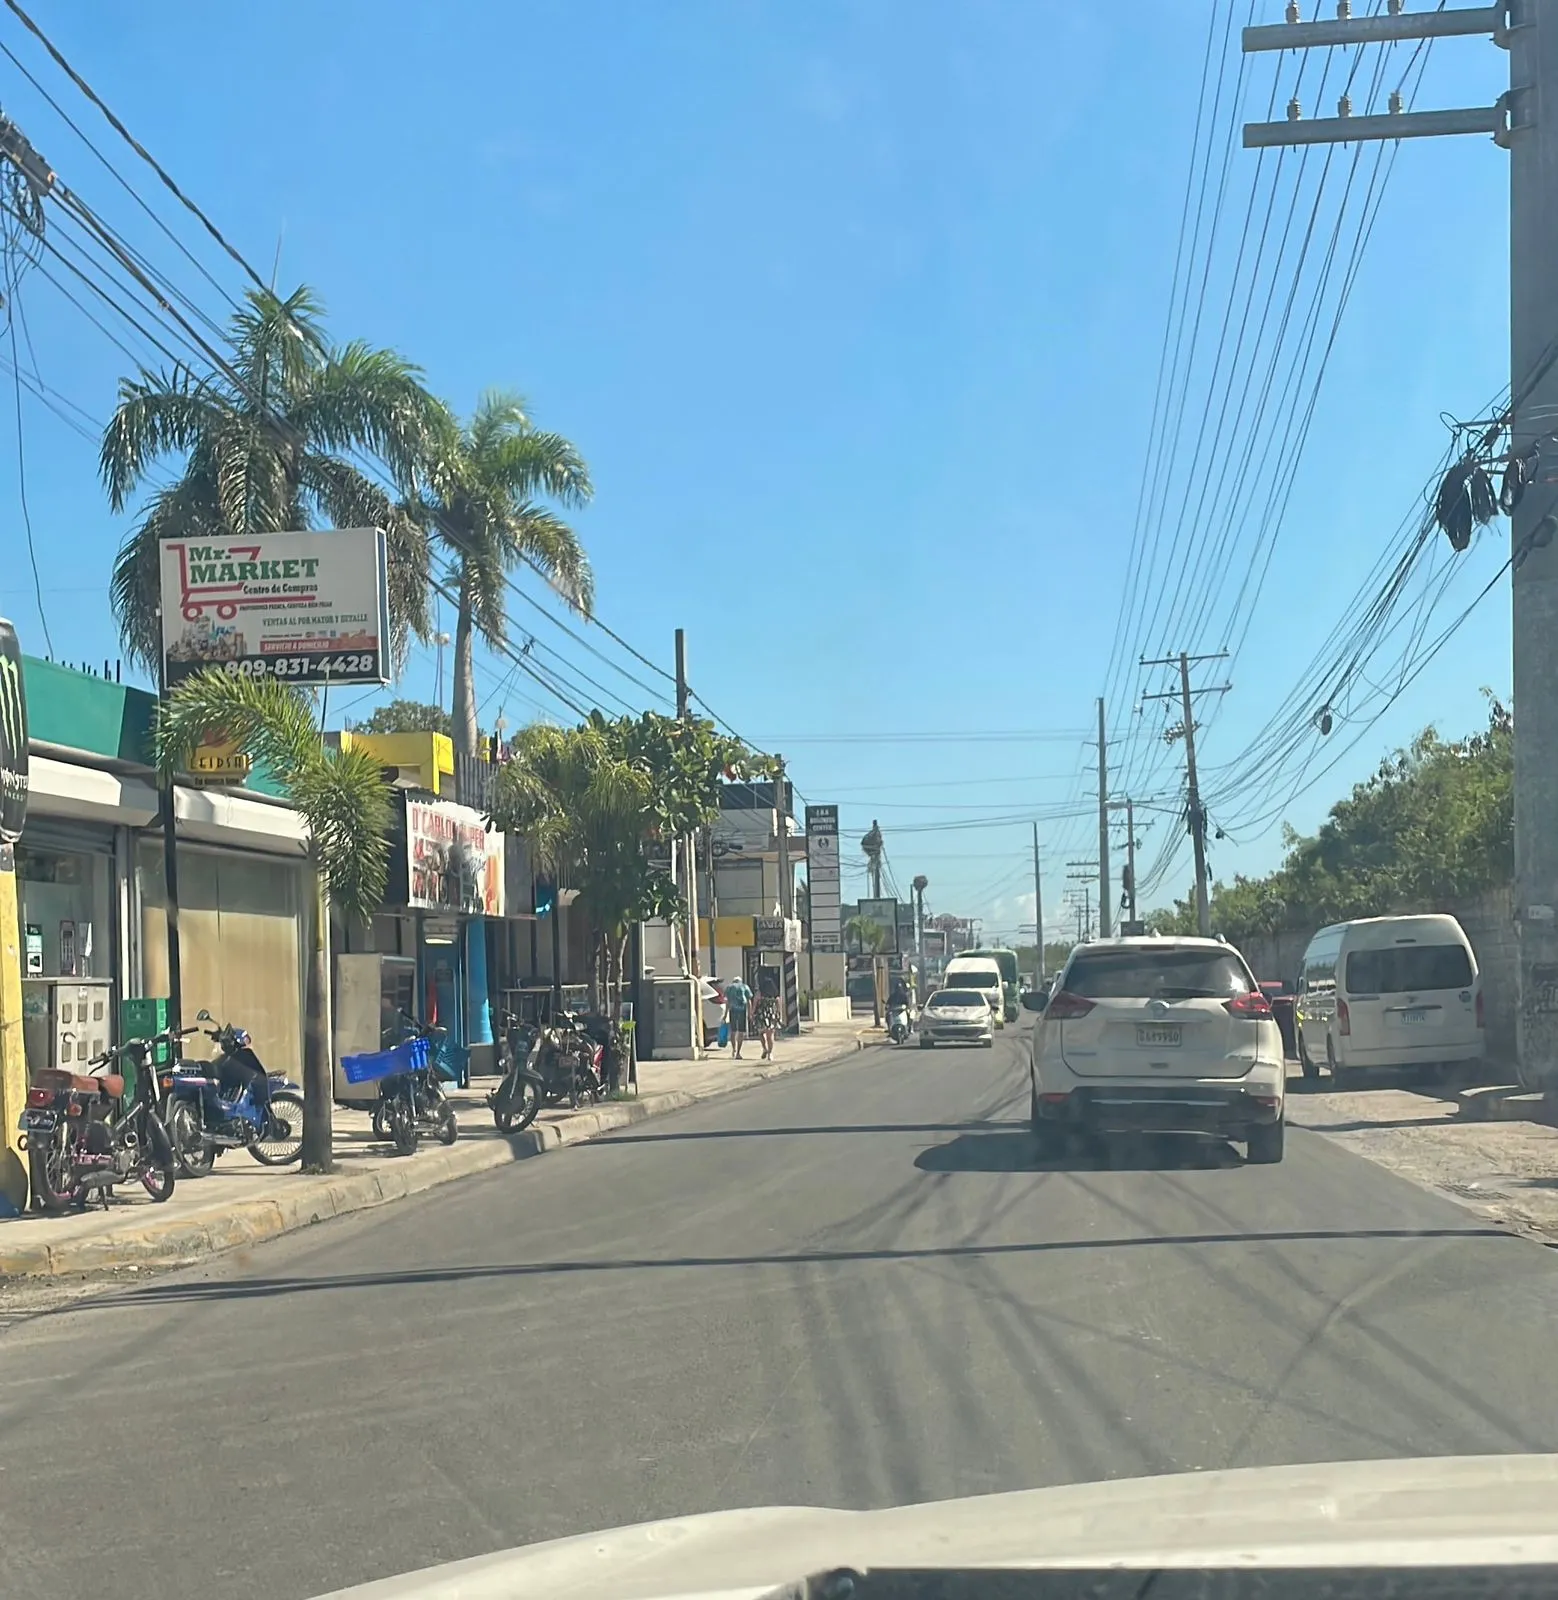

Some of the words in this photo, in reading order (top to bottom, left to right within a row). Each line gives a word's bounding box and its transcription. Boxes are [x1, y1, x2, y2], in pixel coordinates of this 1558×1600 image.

[189, 546, 232, 562] Mr.
[190, 558, 319, 584] MARKET
[243, 585, 270, 595] Centro
[271, 584, 281, 594] de
[282, 583, 318, 595] Compras
[262, 616, 288, 627] VENTAS
[288, 616, 297, 626] AL
[298, 615, 311, 625] POR
[311, 614, 334, 625] MAYOR
[334, 614, 339, 623] Y
[224, 655, 373, 677] 809-831-4428
[0, 766, 28, 790] MONSTE
